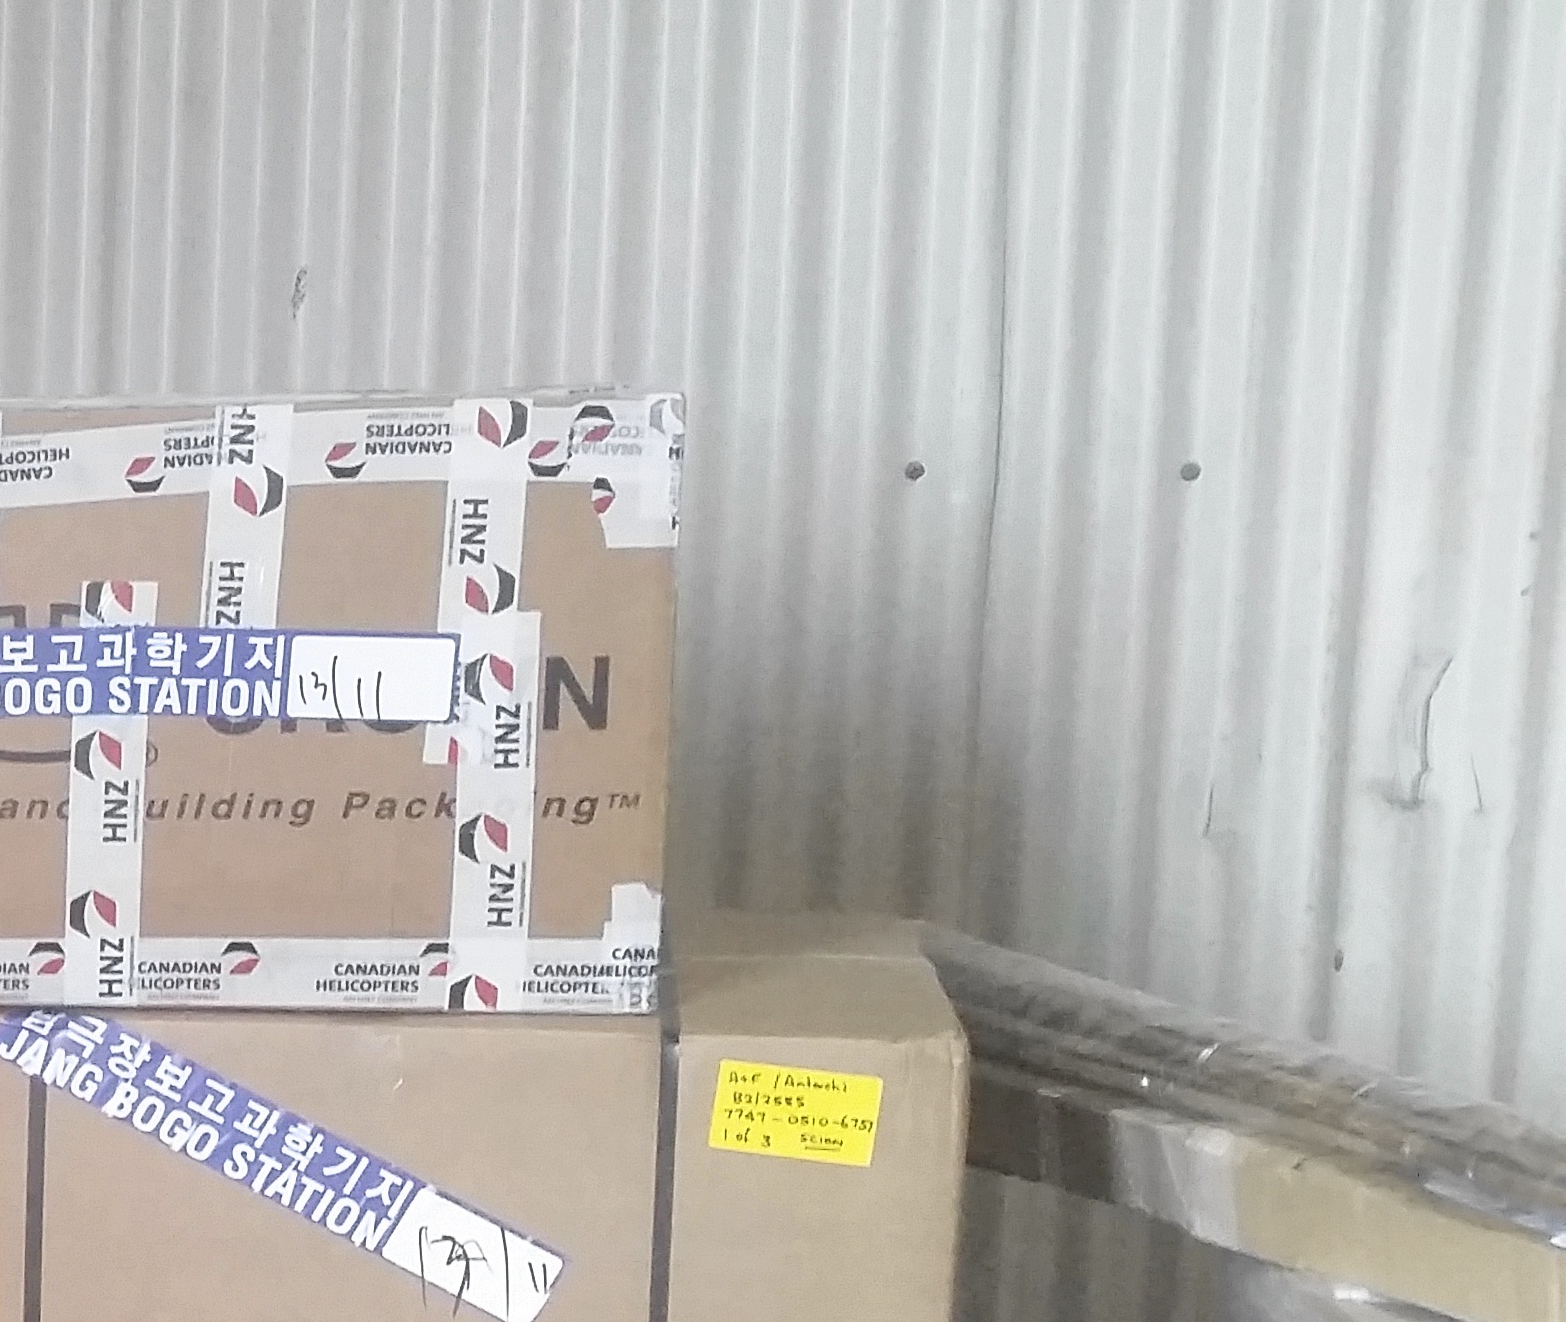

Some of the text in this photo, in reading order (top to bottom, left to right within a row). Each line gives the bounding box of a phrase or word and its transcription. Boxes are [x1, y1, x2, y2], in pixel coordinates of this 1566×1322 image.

[366, 441, 452, 455] CANADIAN
[459, 498, 489, 565] HNZ
[108, 678, 283, 718] STATION
[494, 703, 521, 769] HNZ
[102, 780, 129, 843] HNZ
[487, 863, 515, 927] HNZ
[98, 938, 125, 998] HNZ
[137, 961, 222, 976] CANADIAN
[315, 979, 420, 995] HELICOPTERS
[334, 963, 420, 978] CANADIAN
[101, 1081, 222, 1163] BOGO
[222, 1142, 394, 1255] STATION
